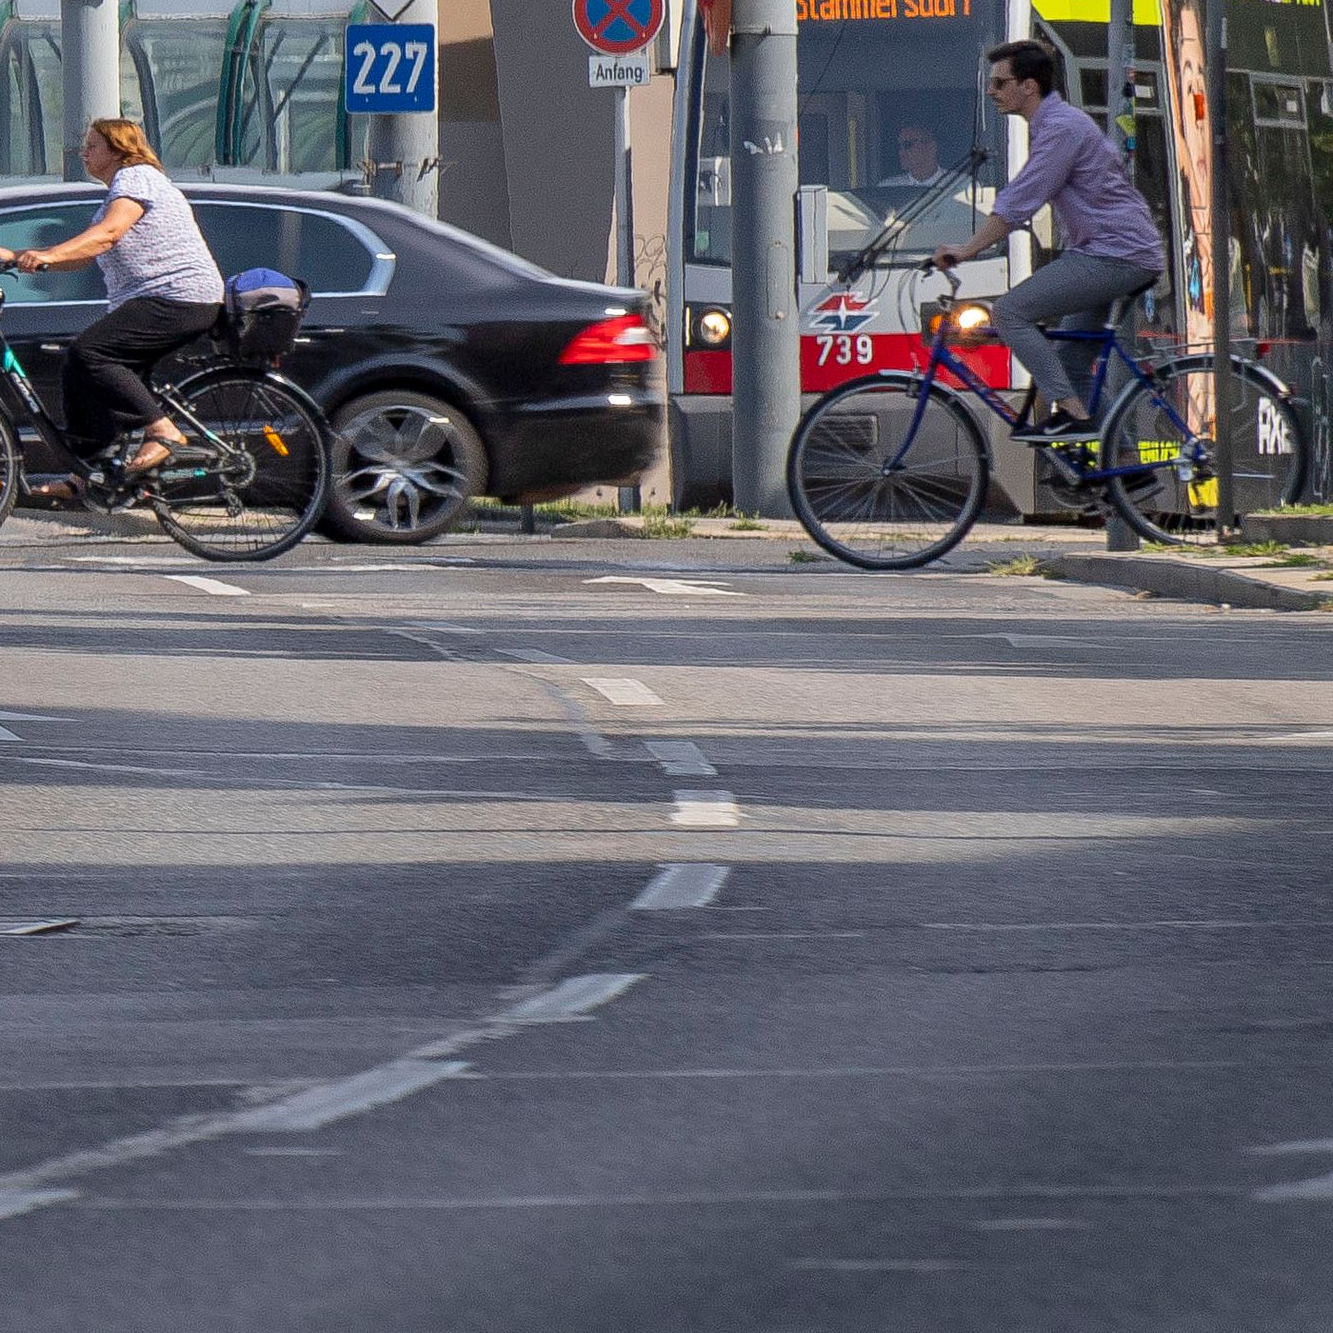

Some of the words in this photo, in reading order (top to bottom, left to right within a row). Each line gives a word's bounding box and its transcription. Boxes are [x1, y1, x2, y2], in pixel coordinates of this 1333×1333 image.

[353, 41, 427, 94] 227
[596, 63, 642, 83] Anfang
[817, 335, 873, 366] 739
